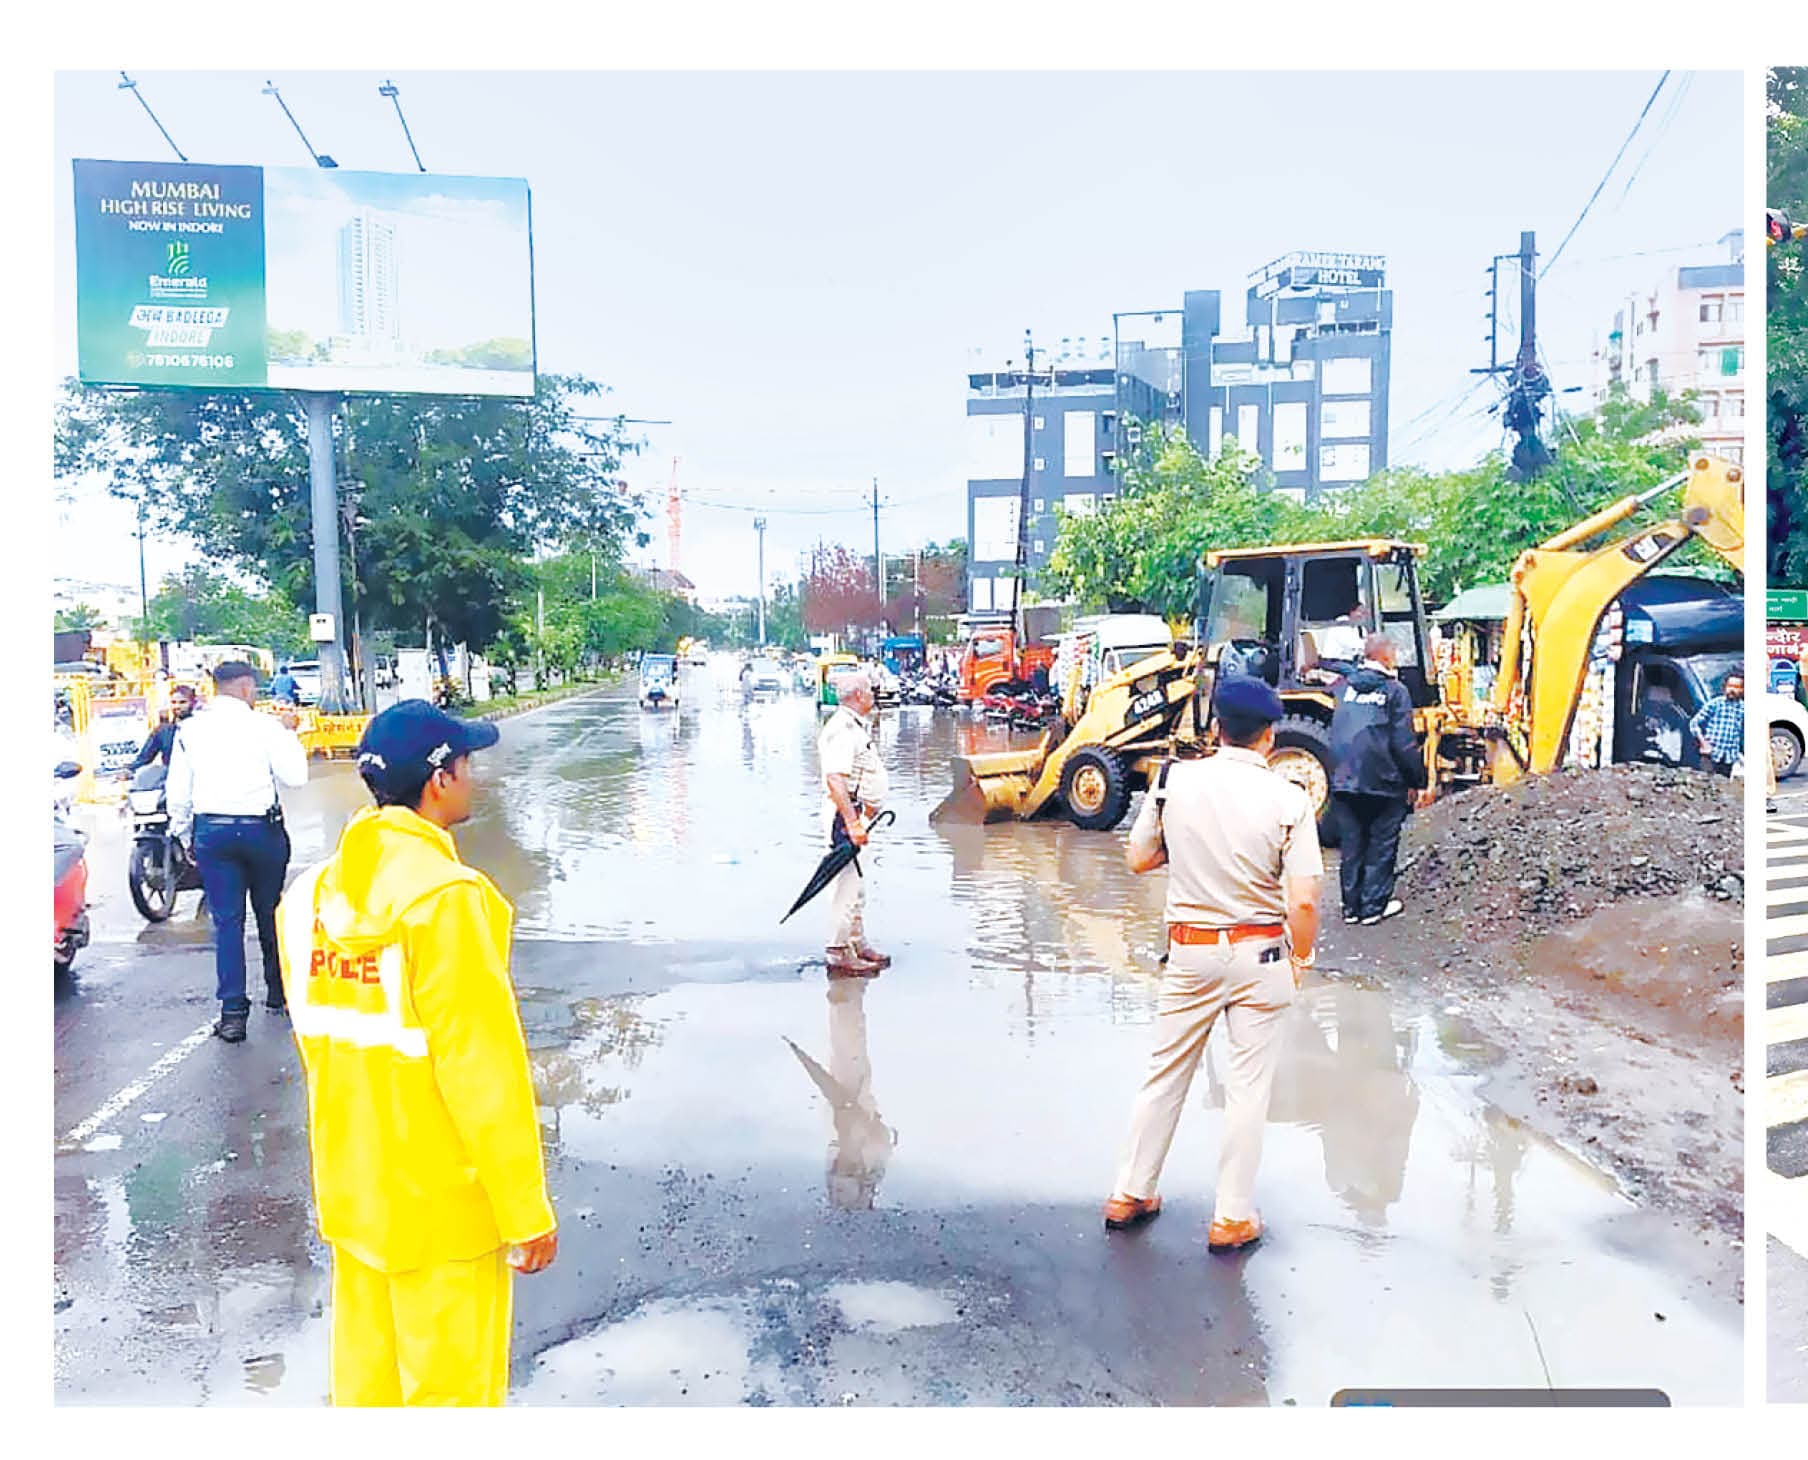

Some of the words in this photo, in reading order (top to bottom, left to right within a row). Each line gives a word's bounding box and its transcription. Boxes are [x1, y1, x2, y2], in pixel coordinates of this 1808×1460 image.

[131, 181, 220, 200] MUMBAI
[101, 199, 147, 215] HIGH
[151, 201, 185, 217] RISE
[194, 203, 252, 219] LIVING
[128, 220, 161, 232] NOW
[163, 222, 177, 232] IN
[178, 222, 224, 234] INDORE
[149, 275, 208, 288] Emerald
[1318, 269, 1362, 285] HOTEL
